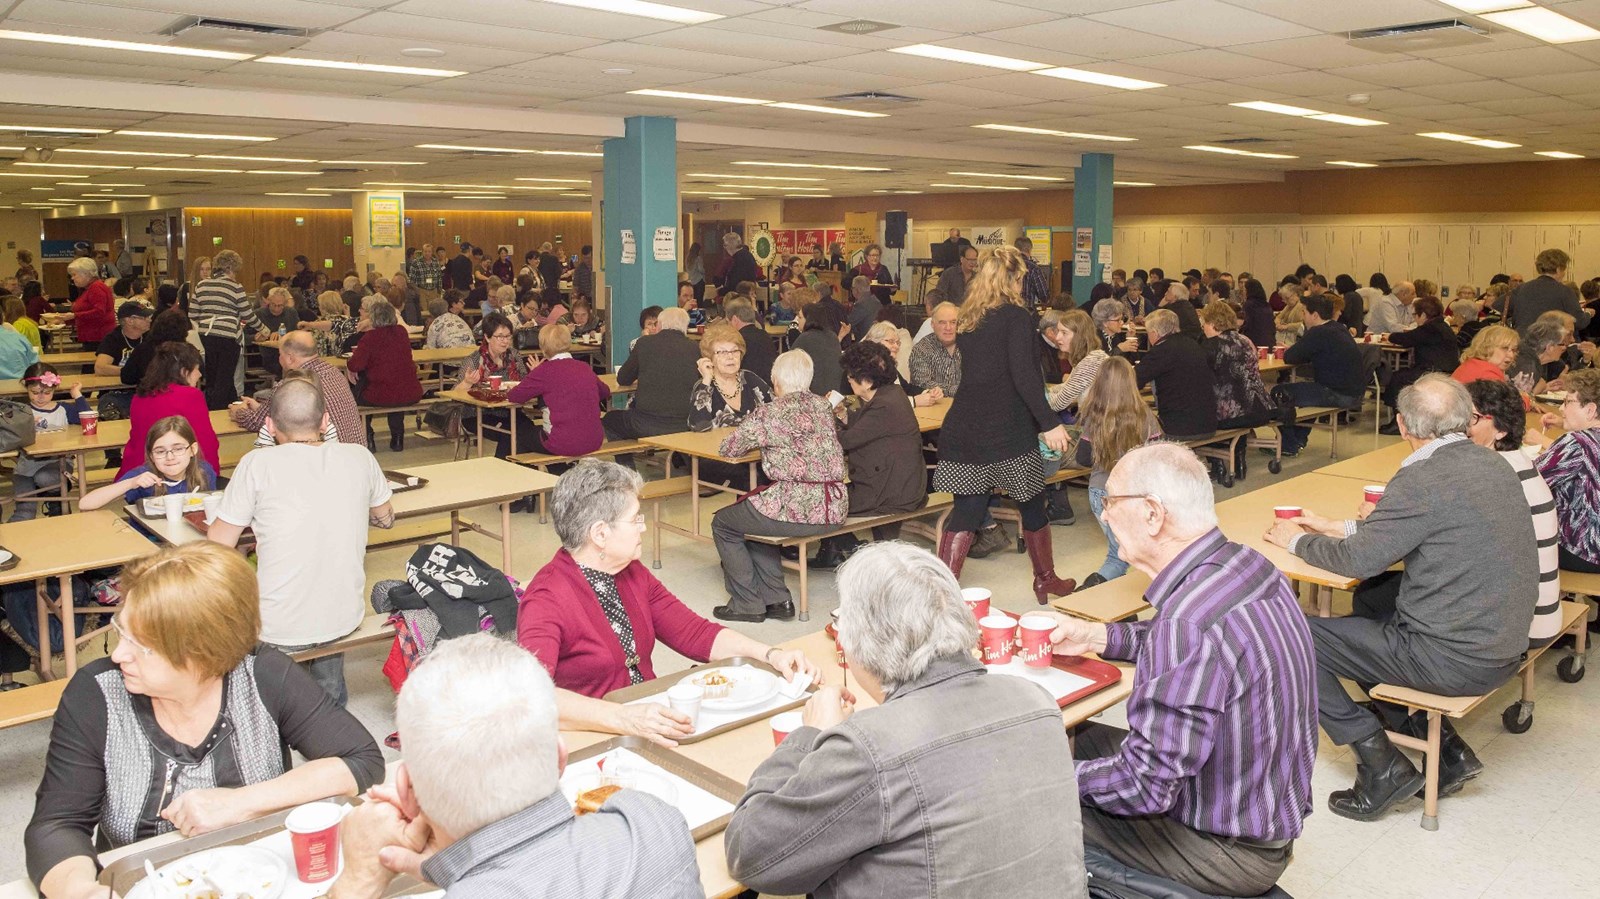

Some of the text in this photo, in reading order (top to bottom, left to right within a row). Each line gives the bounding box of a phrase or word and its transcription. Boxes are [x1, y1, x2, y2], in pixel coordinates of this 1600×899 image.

[776, 231, 789, 243] Tim
[804, 231, 818, 243] Tim
[984, 646, 1001, 660] Tim
[1022, 647, 1038, 662] Tim
